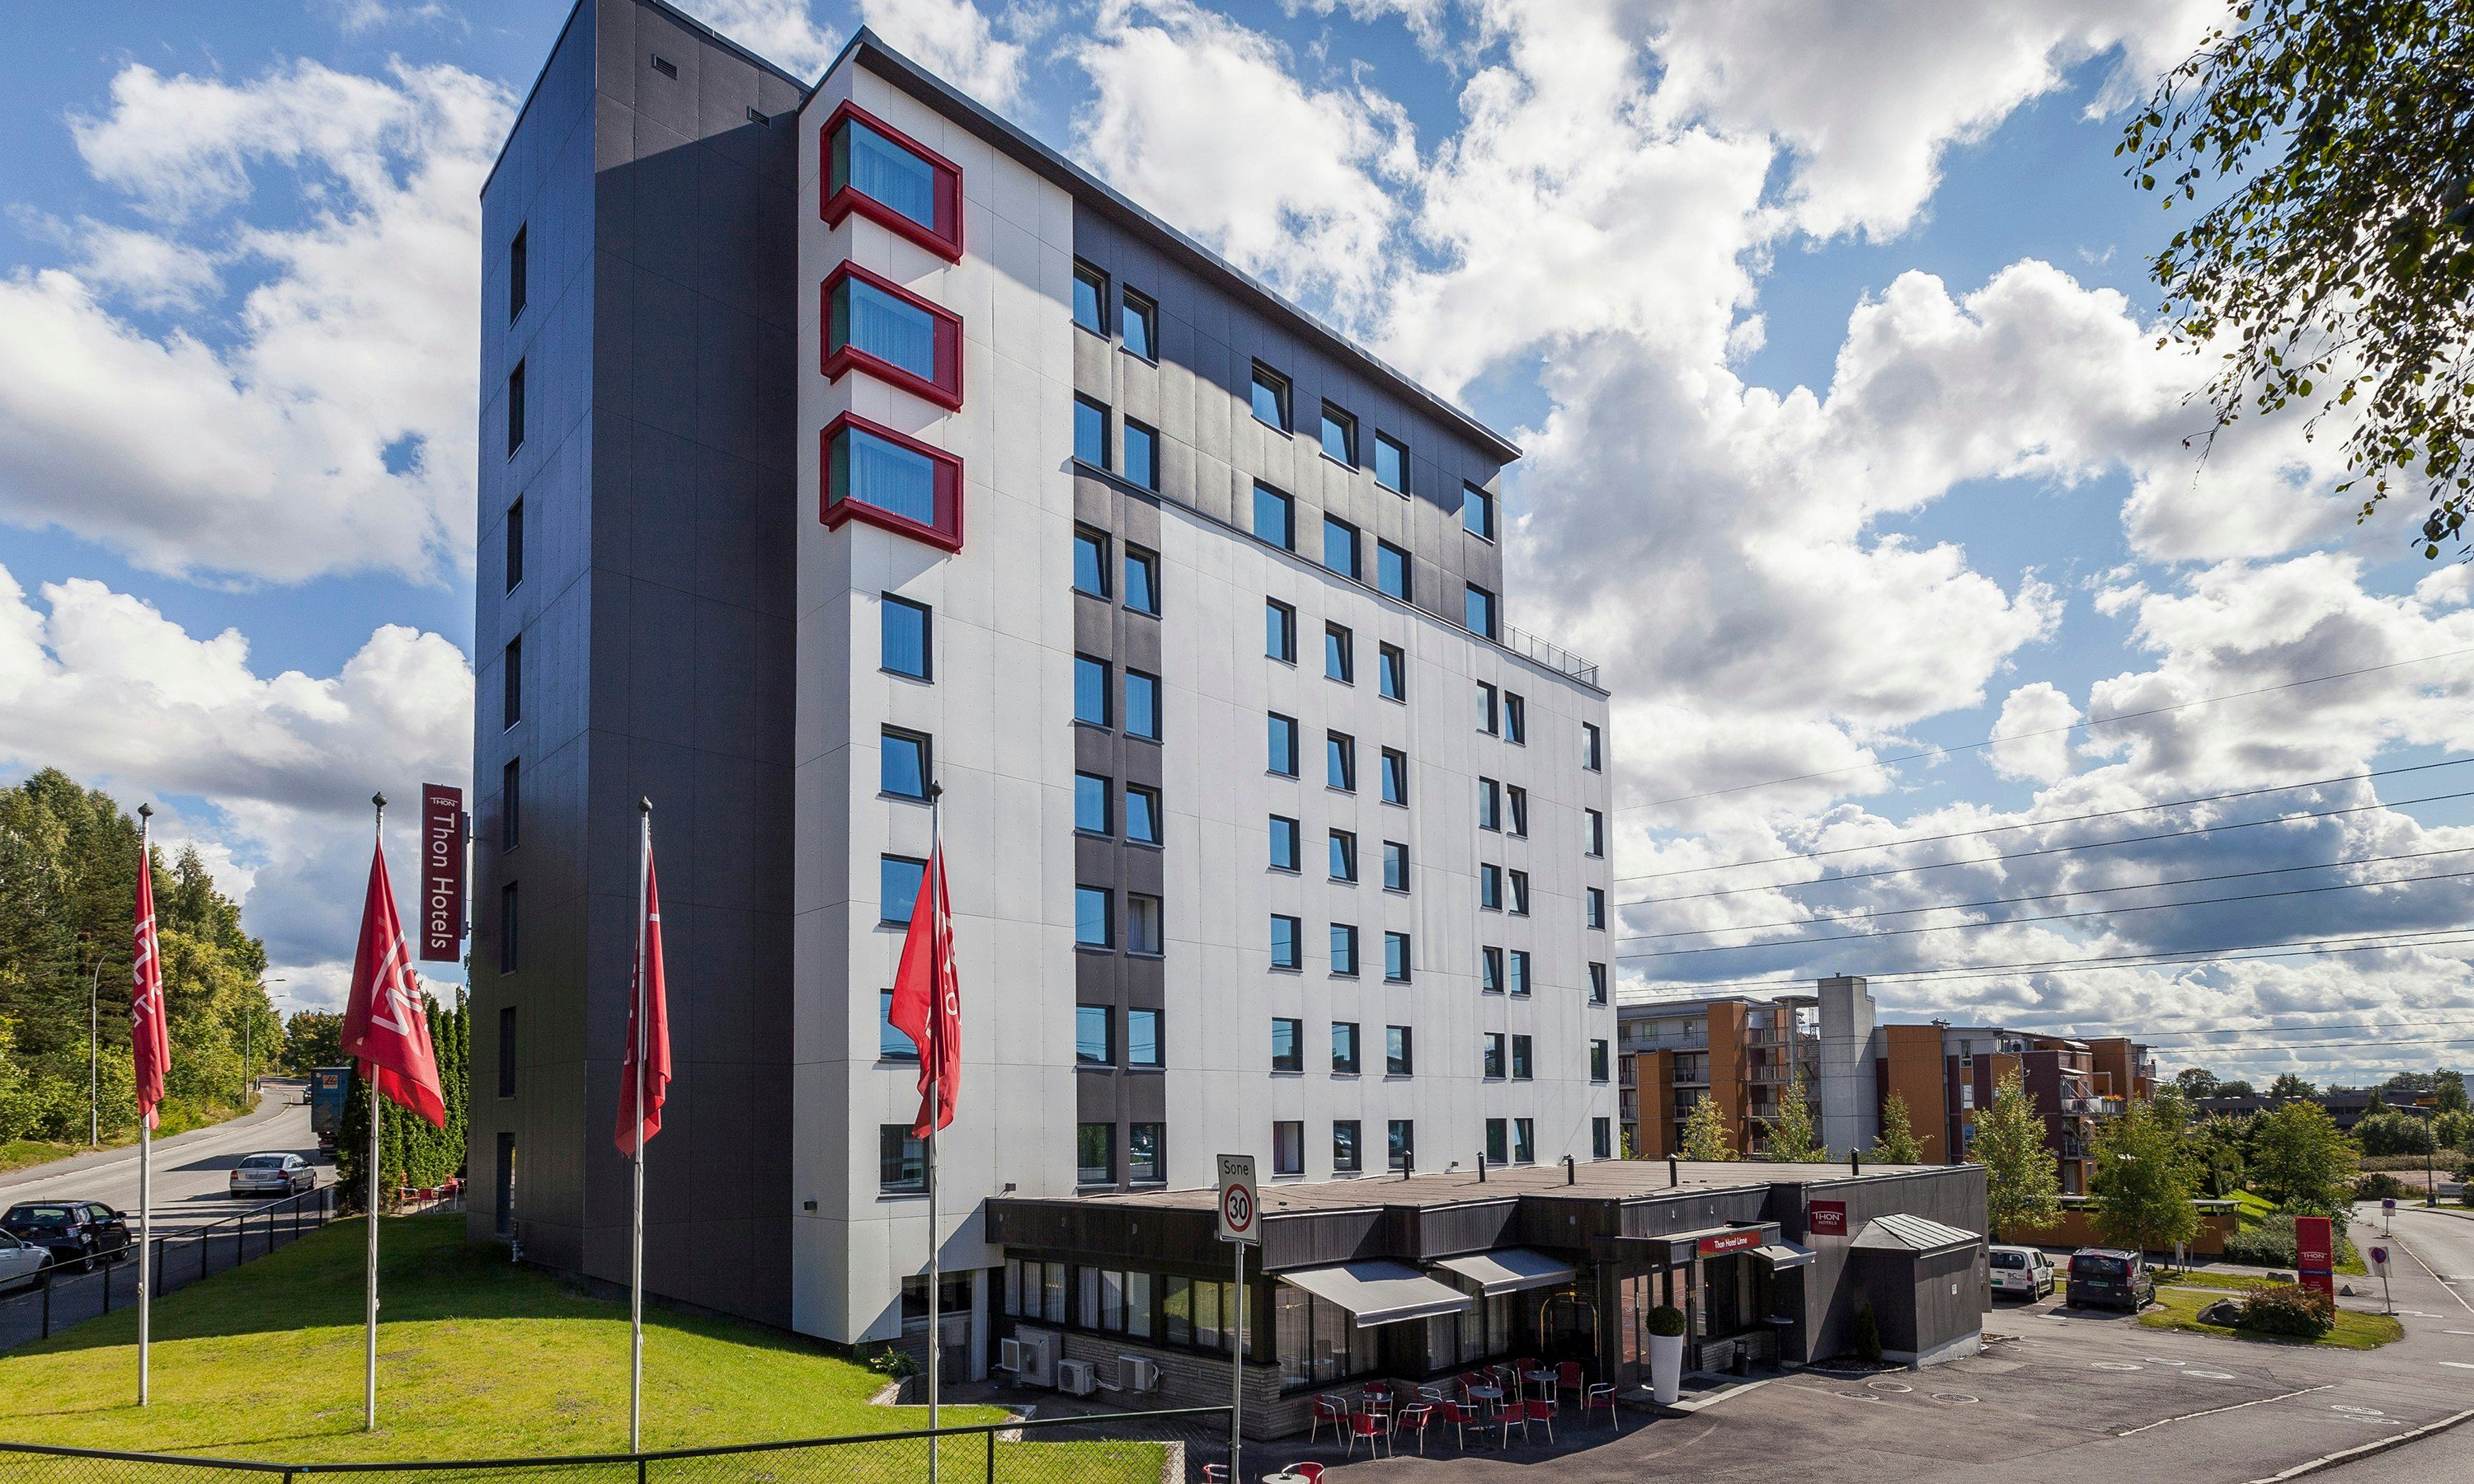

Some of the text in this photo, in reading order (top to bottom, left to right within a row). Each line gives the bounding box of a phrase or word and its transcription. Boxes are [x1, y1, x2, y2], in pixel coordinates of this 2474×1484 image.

[430, 797, 459, 807] THON
[431, 813, 454, 948] Thon Hotels
[1224, 1160, 1249, 1176] Sone
[1230, 1196, 1248, 1220] 30
[1812, 1211, 1843, 1221] THON
[1714, 1240, 1725, 1249] Thon
[1725, 1238, 1737, 1247] Hotel
